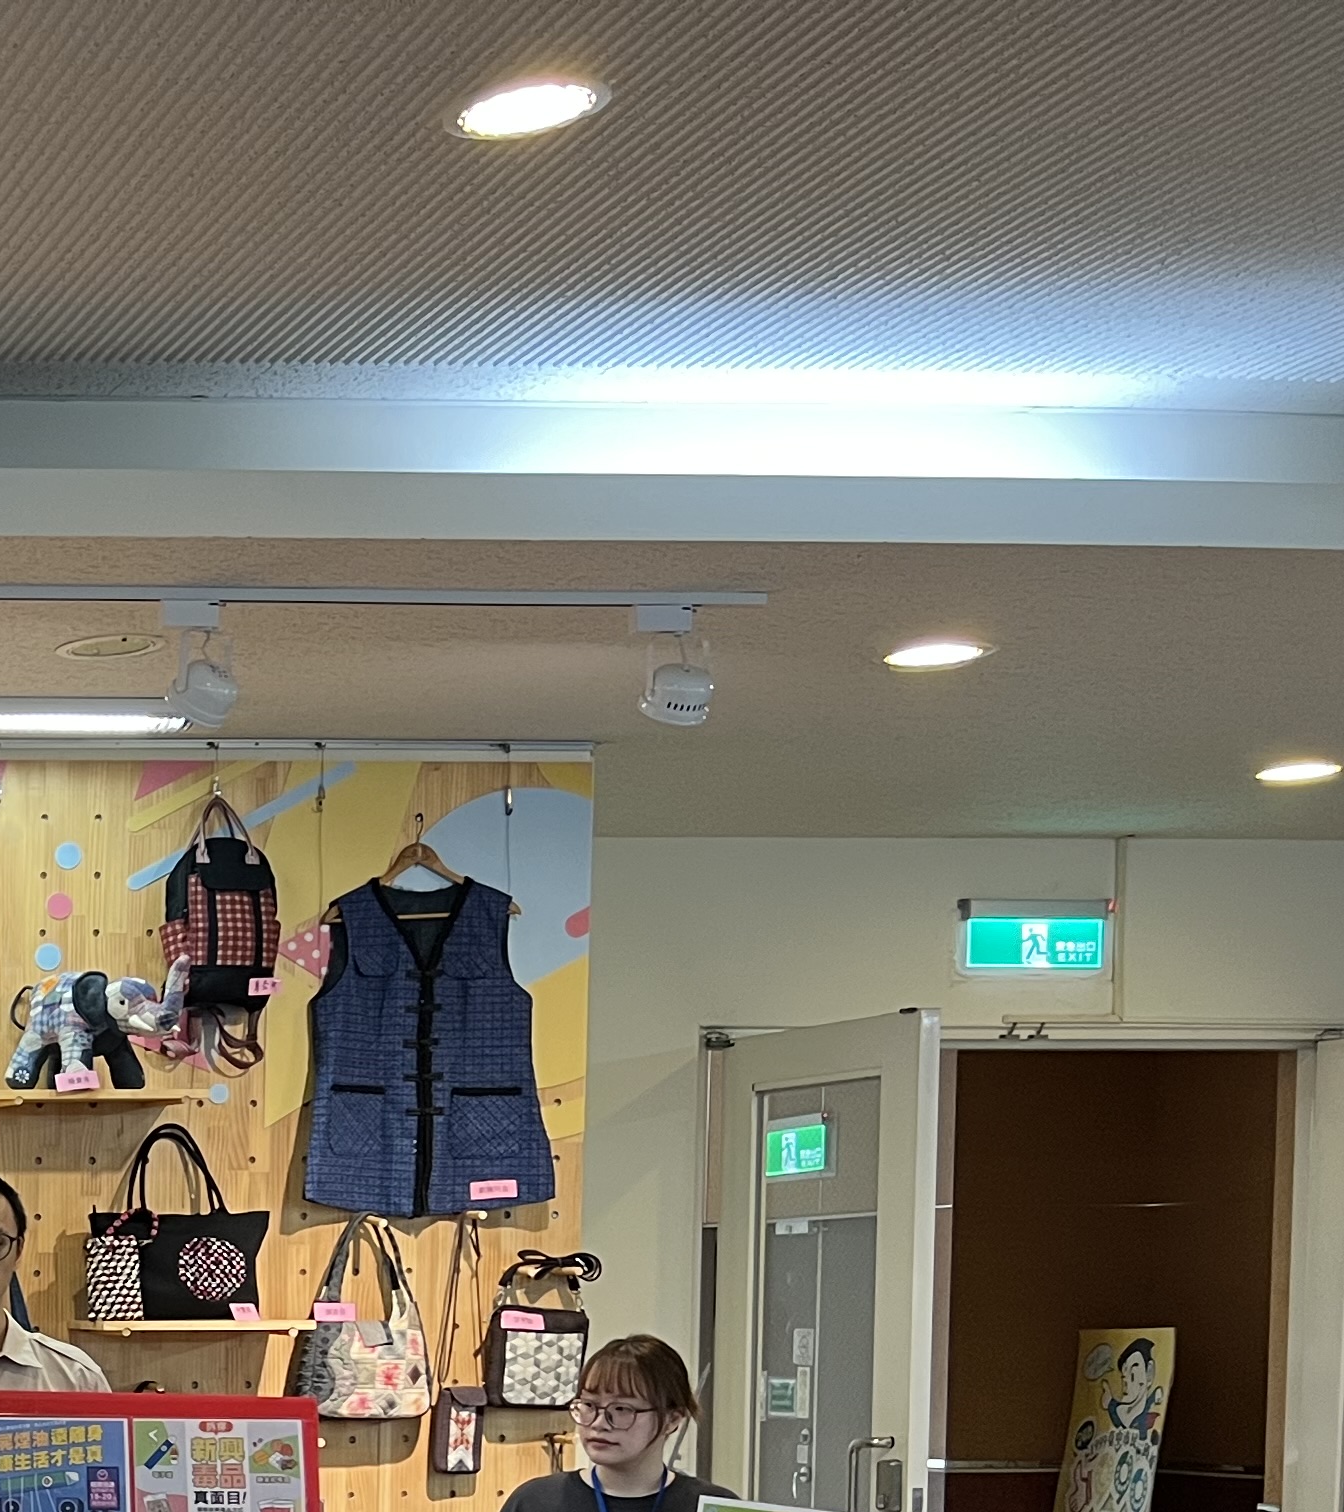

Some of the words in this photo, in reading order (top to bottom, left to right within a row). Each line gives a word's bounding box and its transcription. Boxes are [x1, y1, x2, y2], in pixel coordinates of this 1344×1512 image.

[1057, 952, 1093, 962] EXIT
[191, 1437, 245, 1462] 新興
[192, 1463, 246, 1489] 毒品
